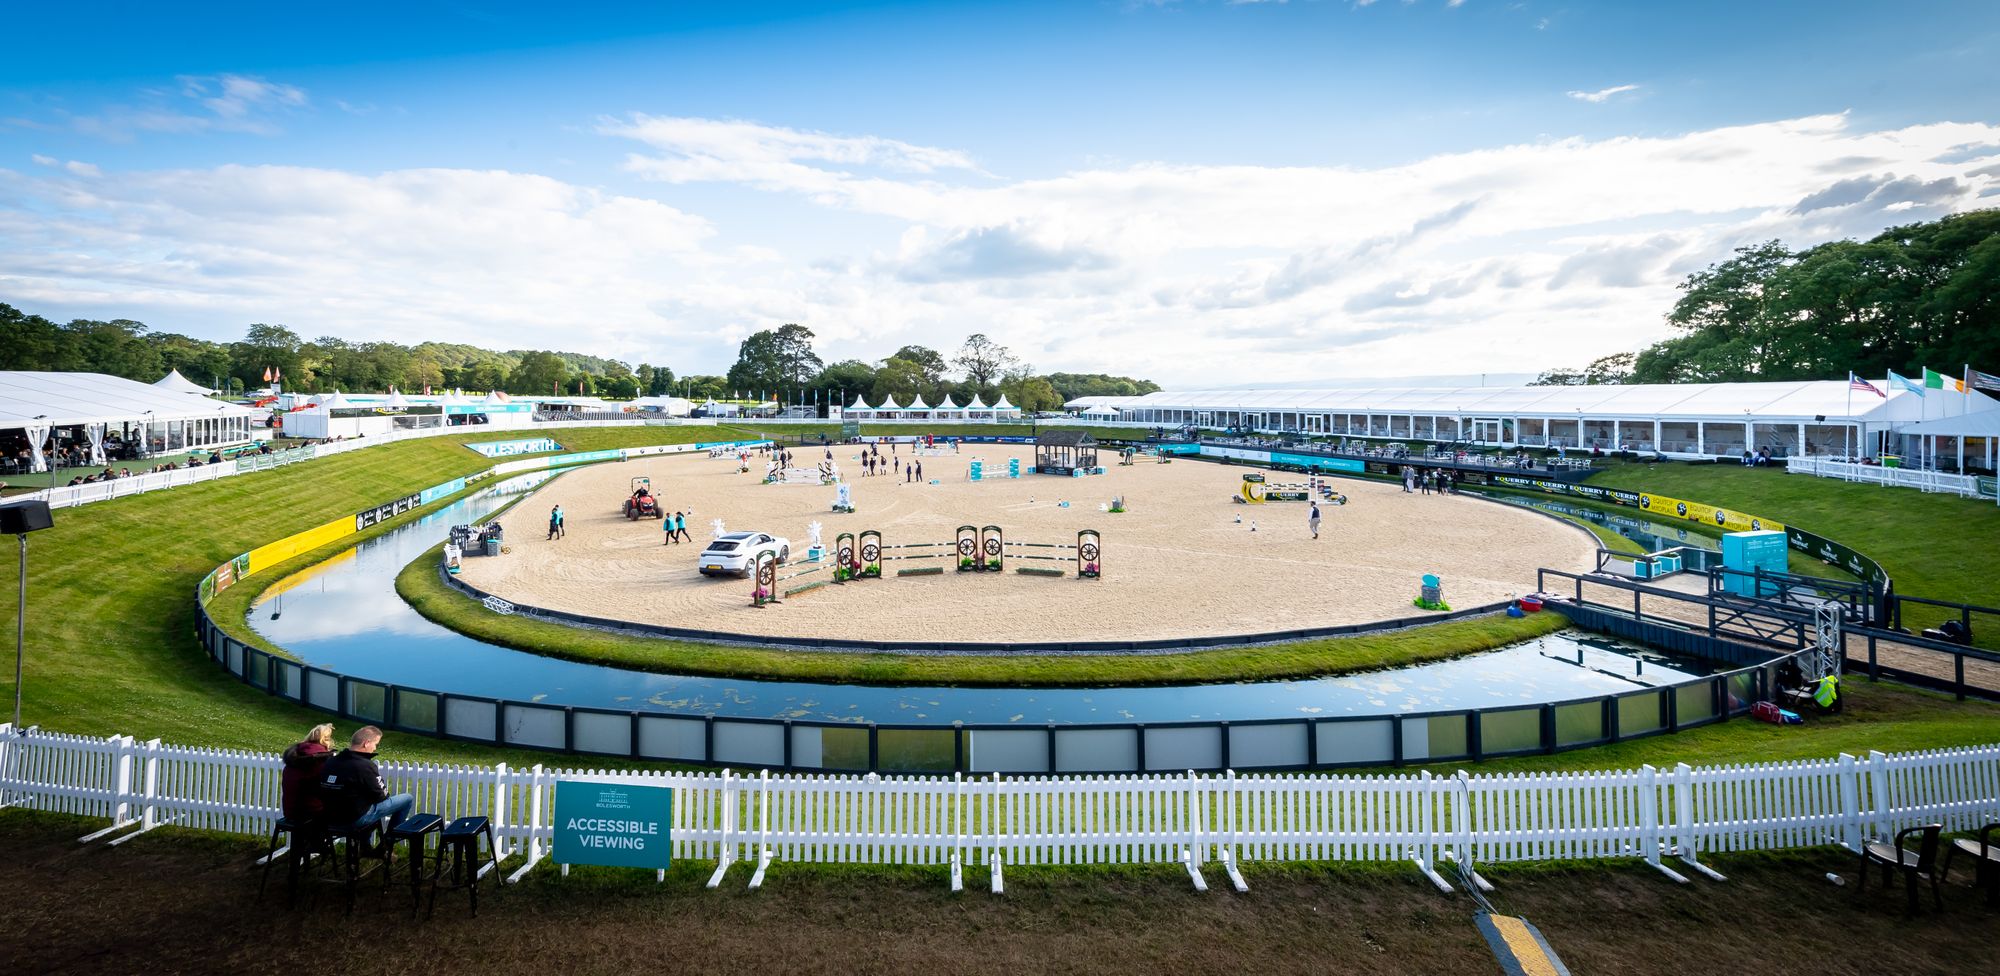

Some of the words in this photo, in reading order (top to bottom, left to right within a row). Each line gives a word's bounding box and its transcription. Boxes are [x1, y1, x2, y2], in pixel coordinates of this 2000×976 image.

[1495, 476, 1530, 485] EQUERRY
[1532, 480, 1568, 489] EQUERRY
[1570, 485, 1603, 496] EQUERRY
[1605, 489, 1639, 501] EQUERRY
[1653, 497, 1674, 506] EQUITOP
[567, 818, 658, 834] ACCESSIBLE
[579, 835, 645, 850] VIEWING
